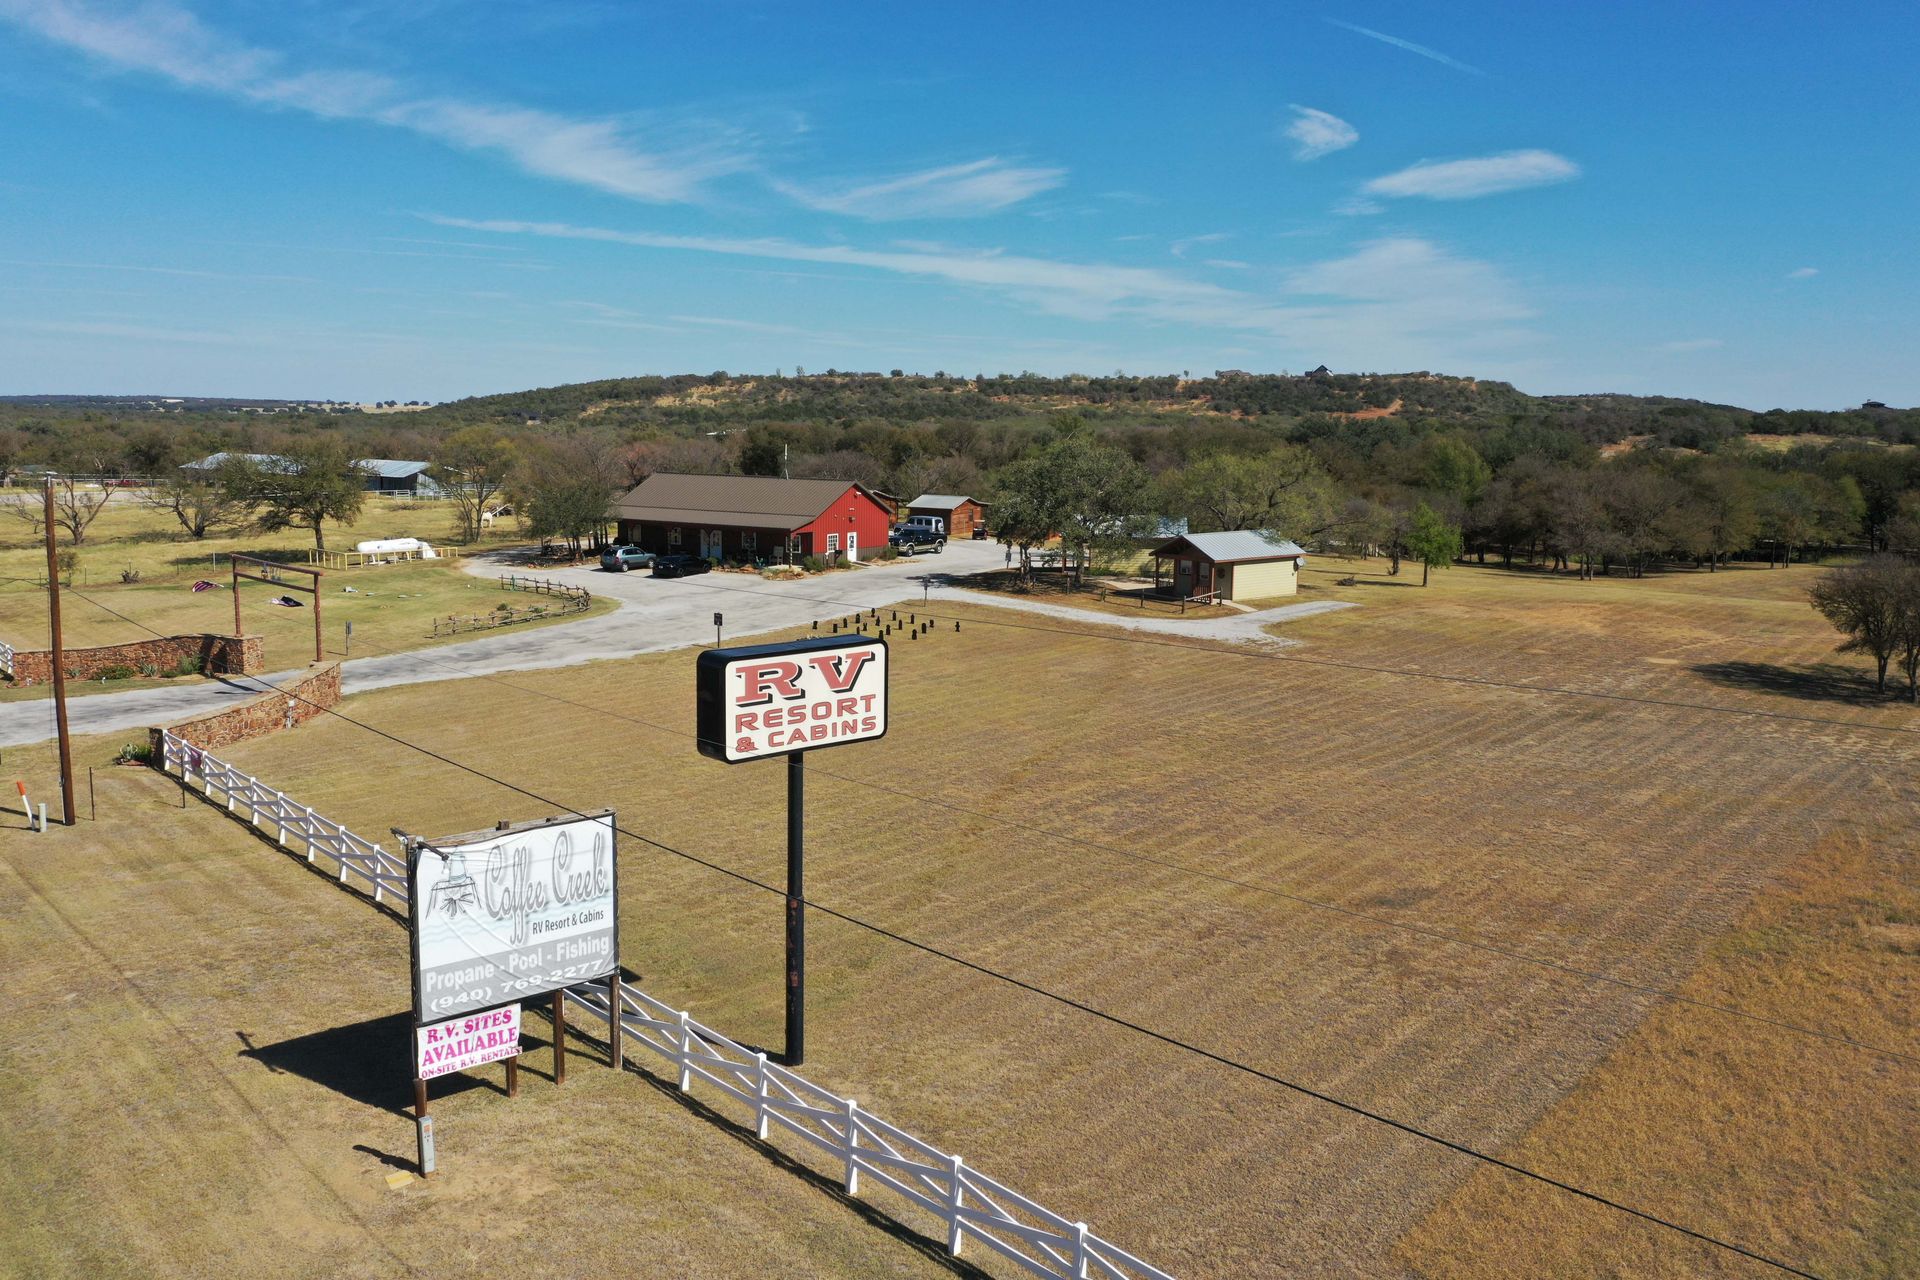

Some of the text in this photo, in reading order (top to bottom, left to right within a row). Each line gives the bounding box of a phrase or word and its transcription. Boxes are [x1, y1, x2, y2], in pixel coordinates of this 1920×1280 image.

[736, 651, 875, 707] RV
[736, 694, 876, 733] RESORT
[735, 716, 877, 753] & CABINS
[485, 830, 608, 945] Coffee Creek
[533, 909, 604, 935] RV Resort & Cabins
[426, 965, 494, 992] Propane
[509, 948, 542, 973] Pool
[556, 935, 609, 962] Fishing
[430, 959, 603, 1013] (940) 769-2277
[427, 1009, 512, 1044] R.V. SITES
[422, 1027, 517, 1067] AVAILABLE
[422, 1062, 457, 1079] ON-SITE
[461, 1055, 477, 1068] R.V.
